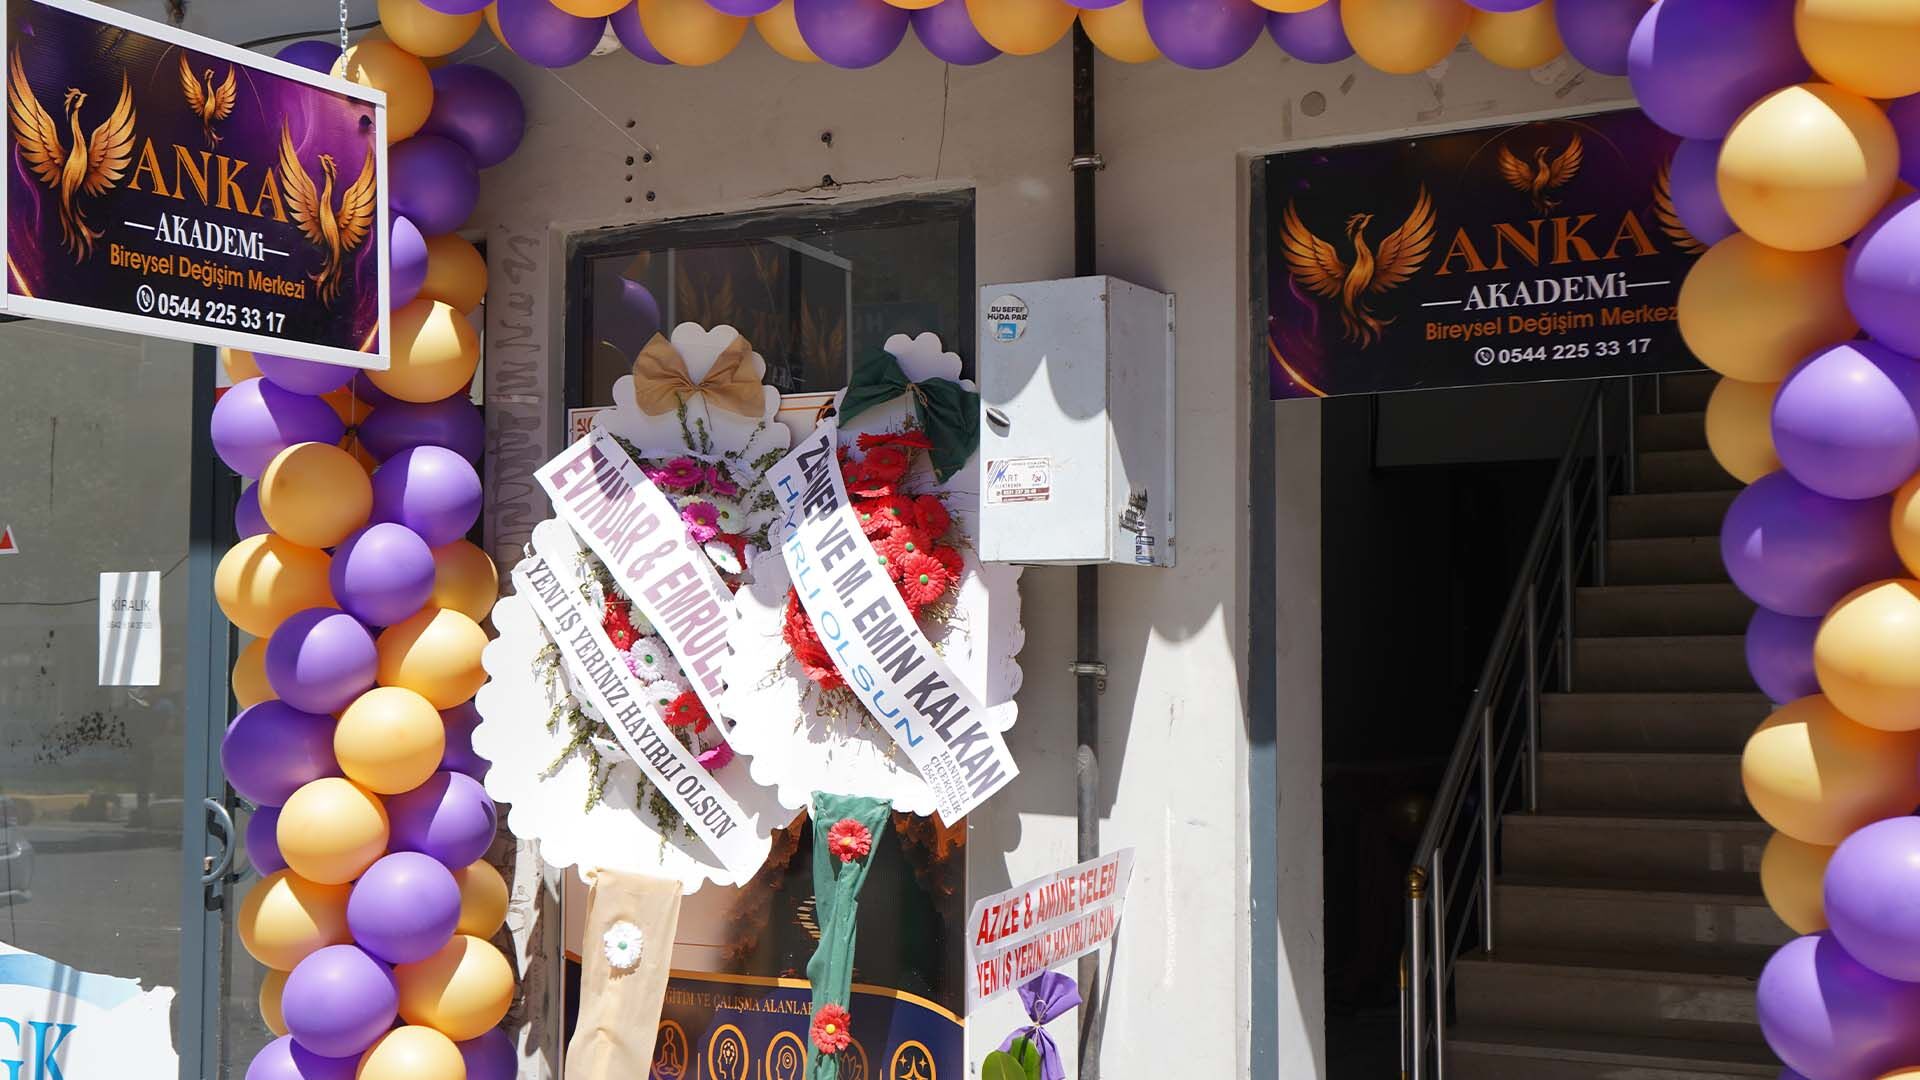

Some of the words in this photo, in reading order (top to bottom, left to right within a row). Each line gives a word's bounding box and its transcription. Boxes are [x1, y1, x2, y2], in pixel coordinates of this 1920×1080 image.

[128, 137, 289, 223] ANKA
[1435, 209, 1661, 276] ANKA
[110, 243, 174, 276] Bireysel
[179, 256, 244, 290] Değişim
[248, 270, 305, 299] Merkezi
[158, 292, 201, 320] 0544
[205, 300, 237, 325] 225
[241, 307, 261, 328] 33
[266, 312, 286, 334] 17
[1425, 316, 1503, 342] Bireysel
[1509, 311, 1594, 336] Değişim
[1602, 303, 1678, 326] Merkez
[1499, 347, 1547, 364] 0544
[1552, 343, 1590, 361] 225
[1595, 341, 1621, 357] 33
[1628, 338, 1652, 354] 17
[626, 539, 679, 584] &
[815, 516, 858, 573] VE
[776, 474, 822, 600] HYIRLI
[820, 610, 925, 748] OLSUN
[832, 557, 874, 609] M.
[851, 595, 926, 685] EMİN
[525, 558, 575, 608] YENİ
[570, 624, 631, 709] YERİNİZ
[616, 700, 686, 783] HAYIRLI
[675, 775, 738, 840] OLSUN
[904, 670, 1007, 800] KALKAN
[1023, 892, 1033, 930] &
[1035, 871, 1076, 924] AMİNE
[1088, 904, 1115, 946] OLSUN
[762, 998, 813, 1016] ALANLAR
